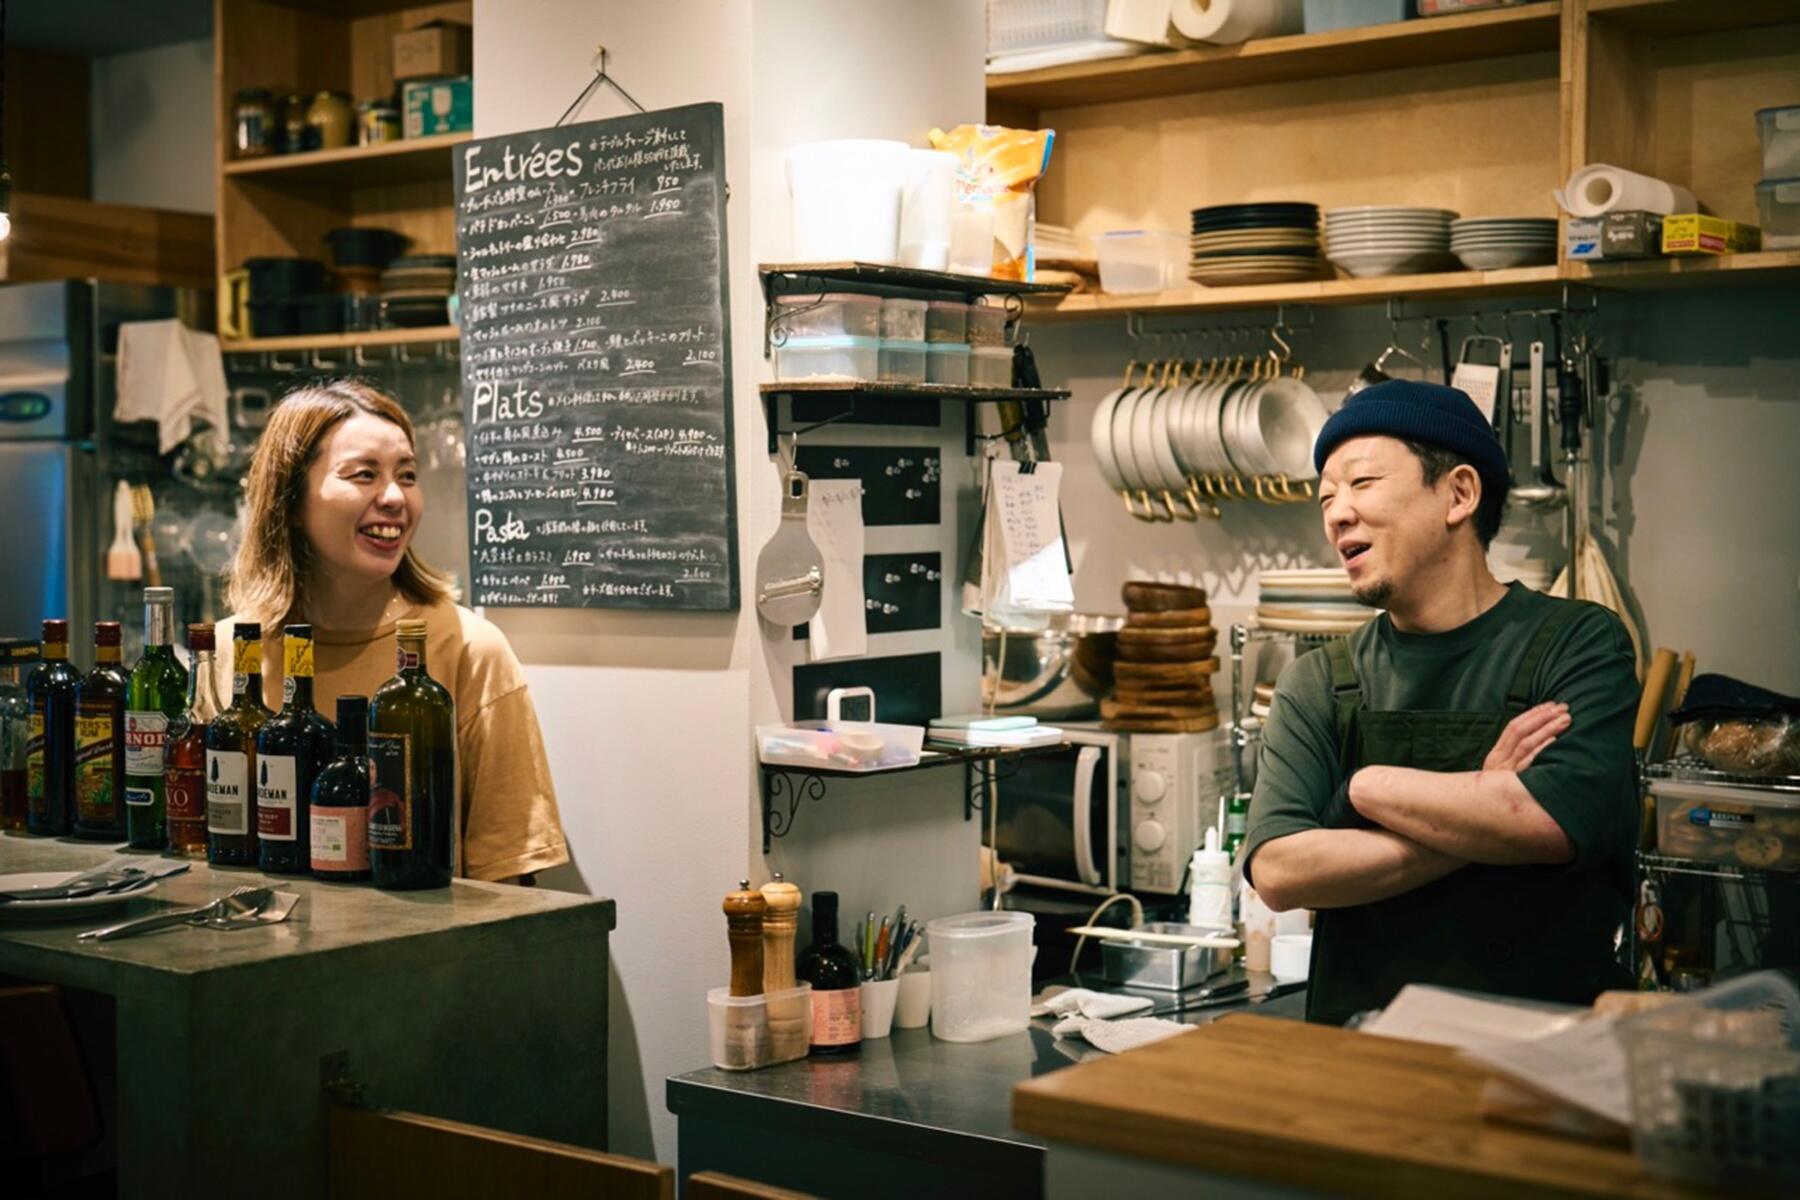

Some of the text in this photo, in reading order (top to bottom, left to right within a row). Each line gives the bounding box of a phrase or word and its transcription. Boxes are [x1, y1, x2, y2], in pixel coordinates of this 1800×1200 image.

[464, 142, 583, 193] Entrées
[579, 174, 679, 200] フレンチフライ 950
[472, 380, 544, 424] Plats
[475, 508, 530, 545] Pasta
